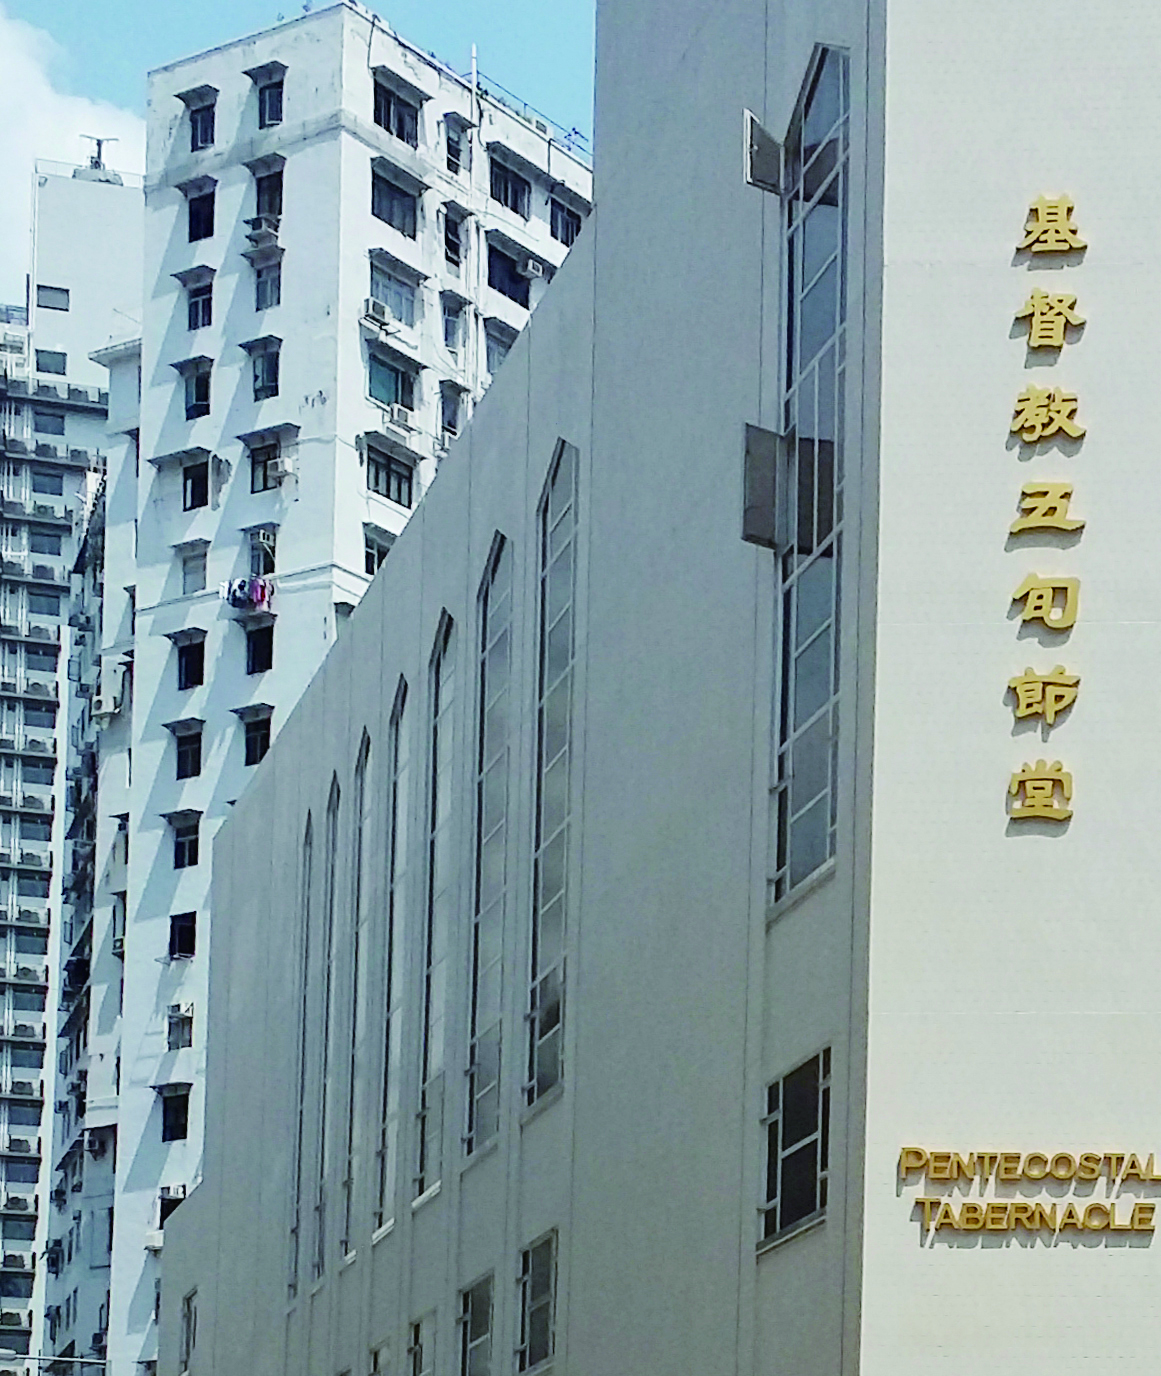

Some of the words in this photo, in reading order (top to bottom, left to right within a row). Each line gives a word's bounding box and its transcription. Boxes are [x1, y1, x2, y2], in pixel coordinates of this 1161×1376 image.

[1008, 193, 1088, 820] 基督教五旬節堂
[914, 1197, 1156, 1232] TABERNACLE
